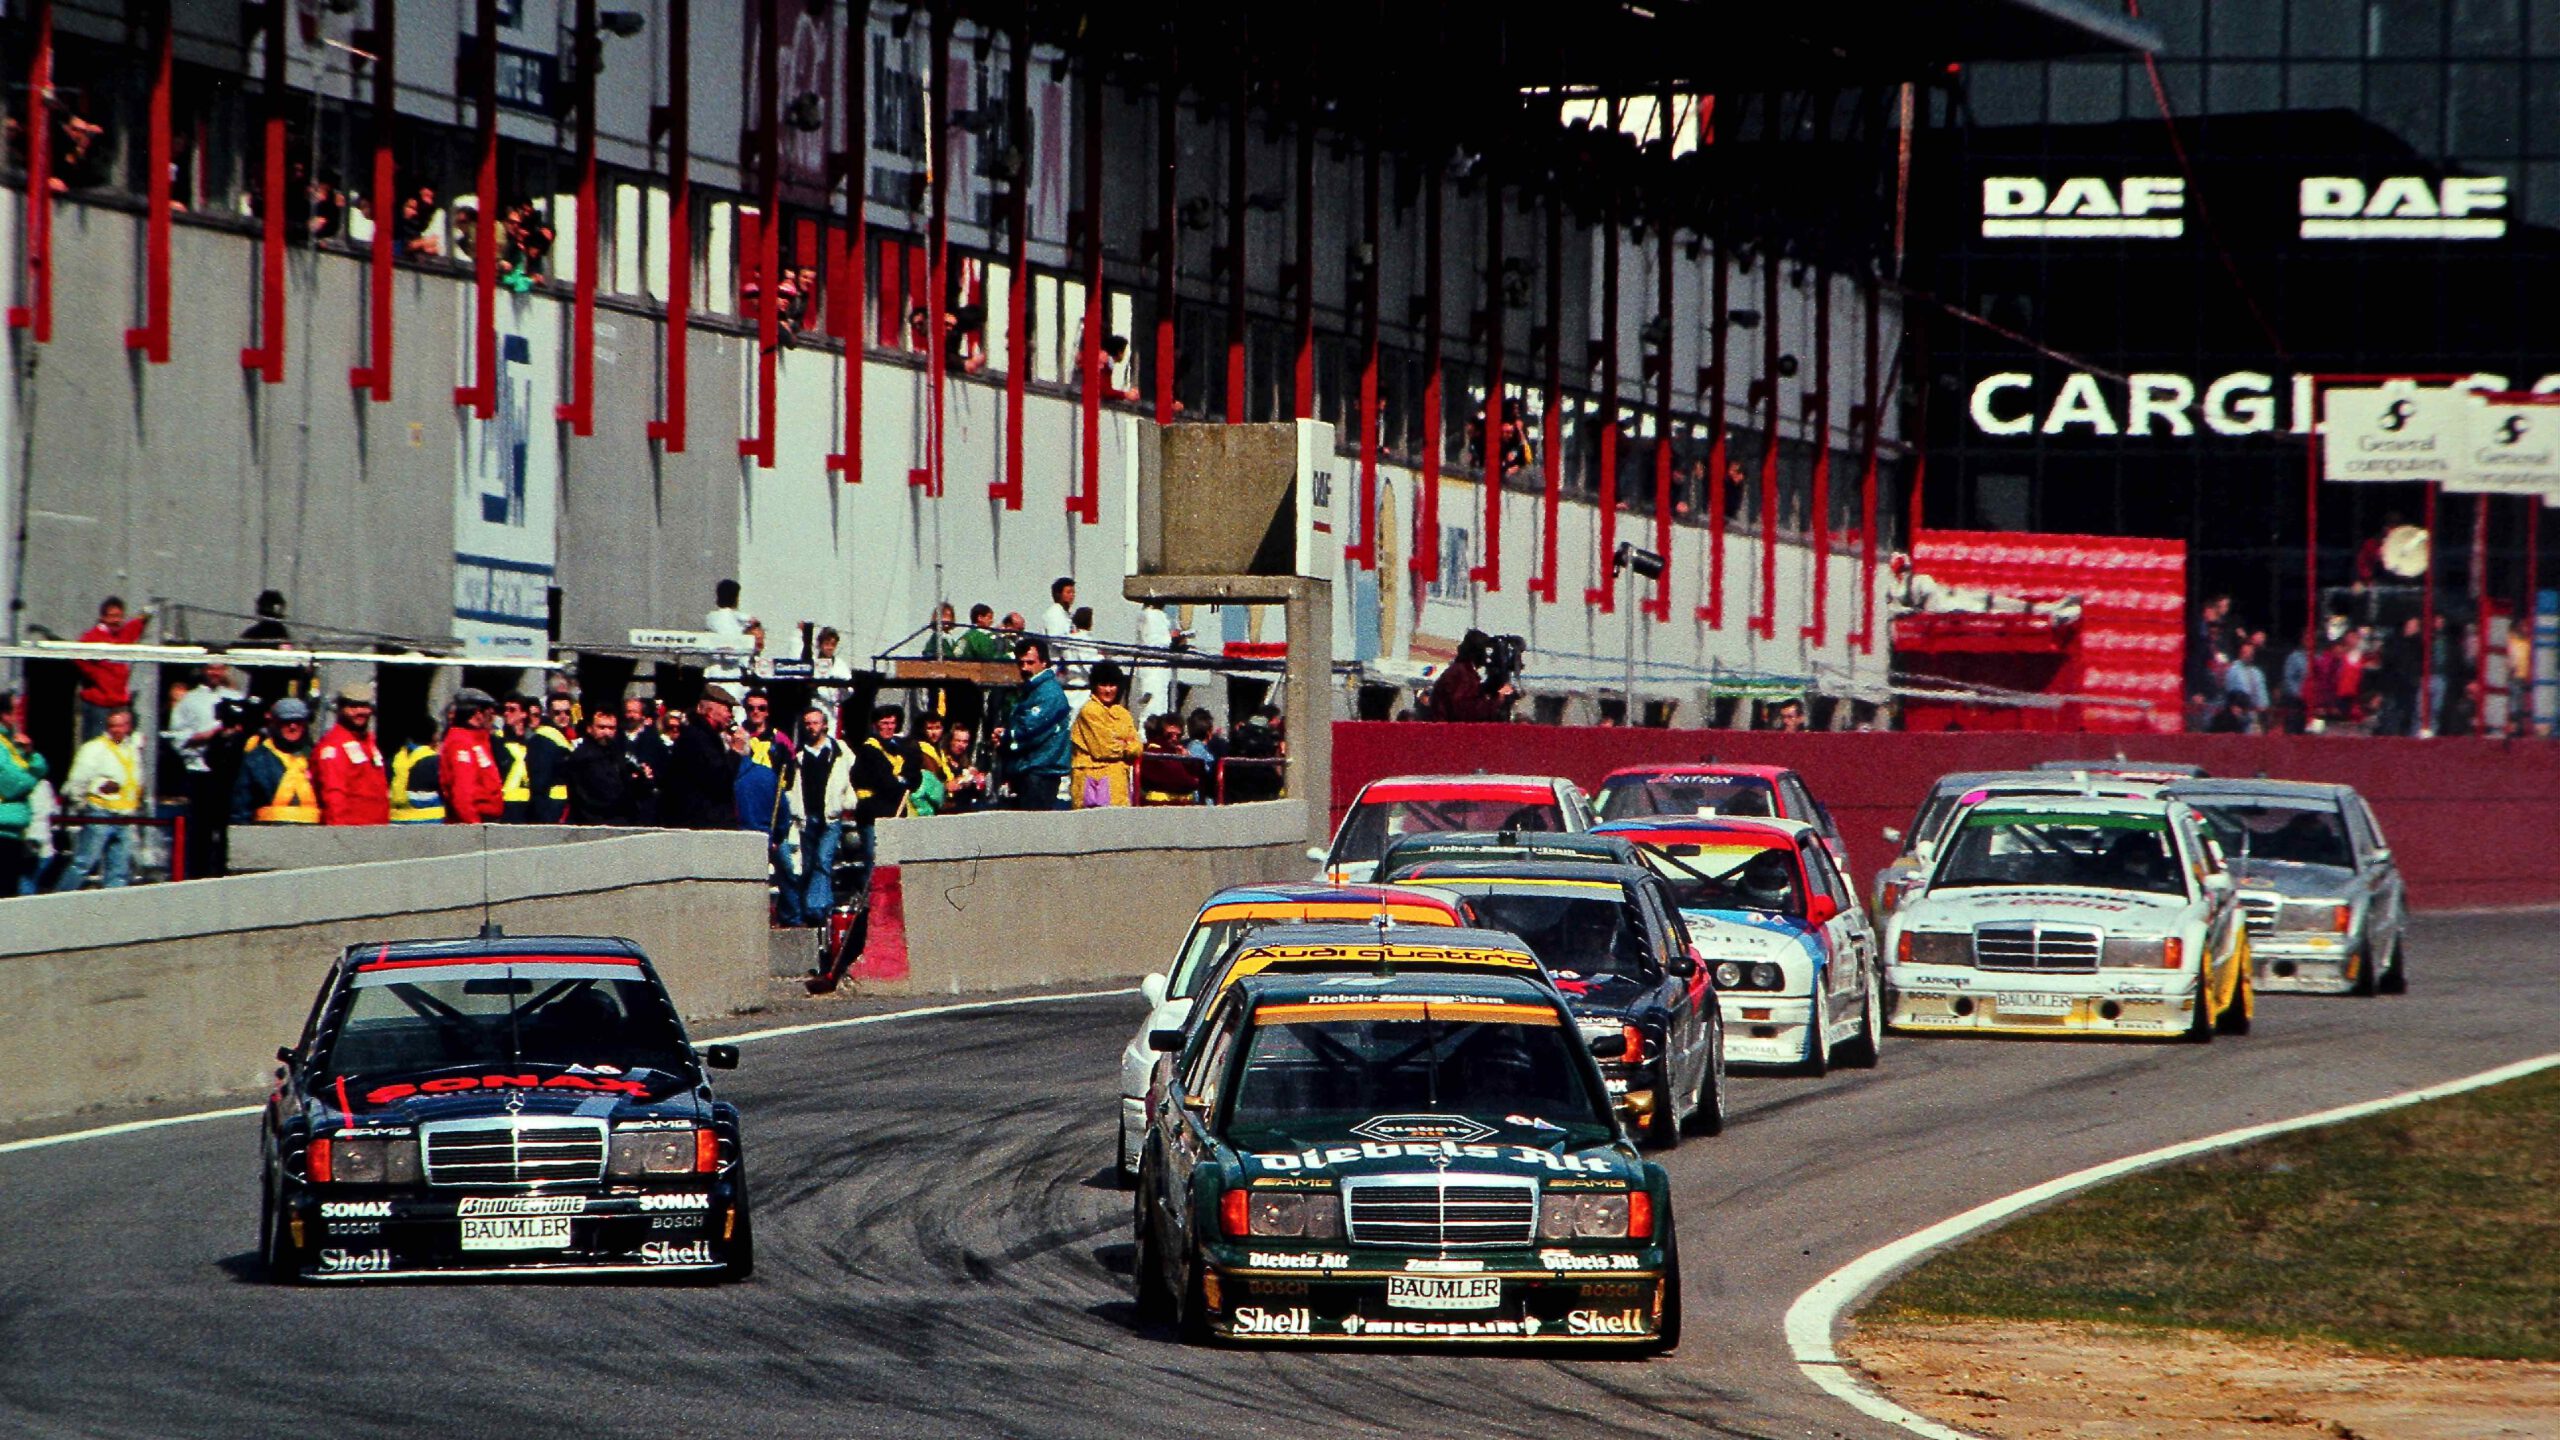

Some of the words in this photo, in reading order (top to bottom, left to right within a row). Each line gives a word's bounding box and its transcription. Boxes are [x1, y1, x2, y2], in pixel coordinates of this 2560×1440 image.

[1983, 177, 2185, 216] DAF
[2300, 177, 2508, 217] DAF
[2358, 434, 2436, 452] General
[1239, 947, 1347, 961] Audi
[1357, 948, 1534, 967] quattro
[366, 1074, 651, 1104] SONAX
[360, 1127, 412, 1137] AMG
[641, 1119, 692, 1129] AMG
[1250, 1140, 1500, 1176] Diebels
[1509, 1144, 1613, 1174] Alt
[1276, 1178, 1334, 1188] AMG
[1569, 1179, 1627, 1188] AMG
[320, 1201, 393, 1218] SONAX
[640, 1193, 710, 1210] SONAX
[327, 1222, 381, 1235] BOSCH
[463, 1217, 570, 1240] BAUMLER
[651, 1215, 704, 1229] BOSCH
[318, 1248, 391, 1273] Shell
[640, 1241, 714, 1265] Shell
[1249, 1251, 1317, 1269] Diebels
[1318, 1251, 1350, 1269] Alt
[1542, 1254, 1608, 1270] Diebels
[1609, 1254, 1641, 1270] Alt
[1250, 1280, 1309, 1295] BOSCH
[1390, 1276, 1499, 1299] BAUMLER
[1579, 1284, 1640, 1297] BOSCH
[1233, 1306, 1310, 1334] Shell
[1364, 1321, 1520, 1334] MICHELIN
[1567, 1308, 1646, 1335] Shell
